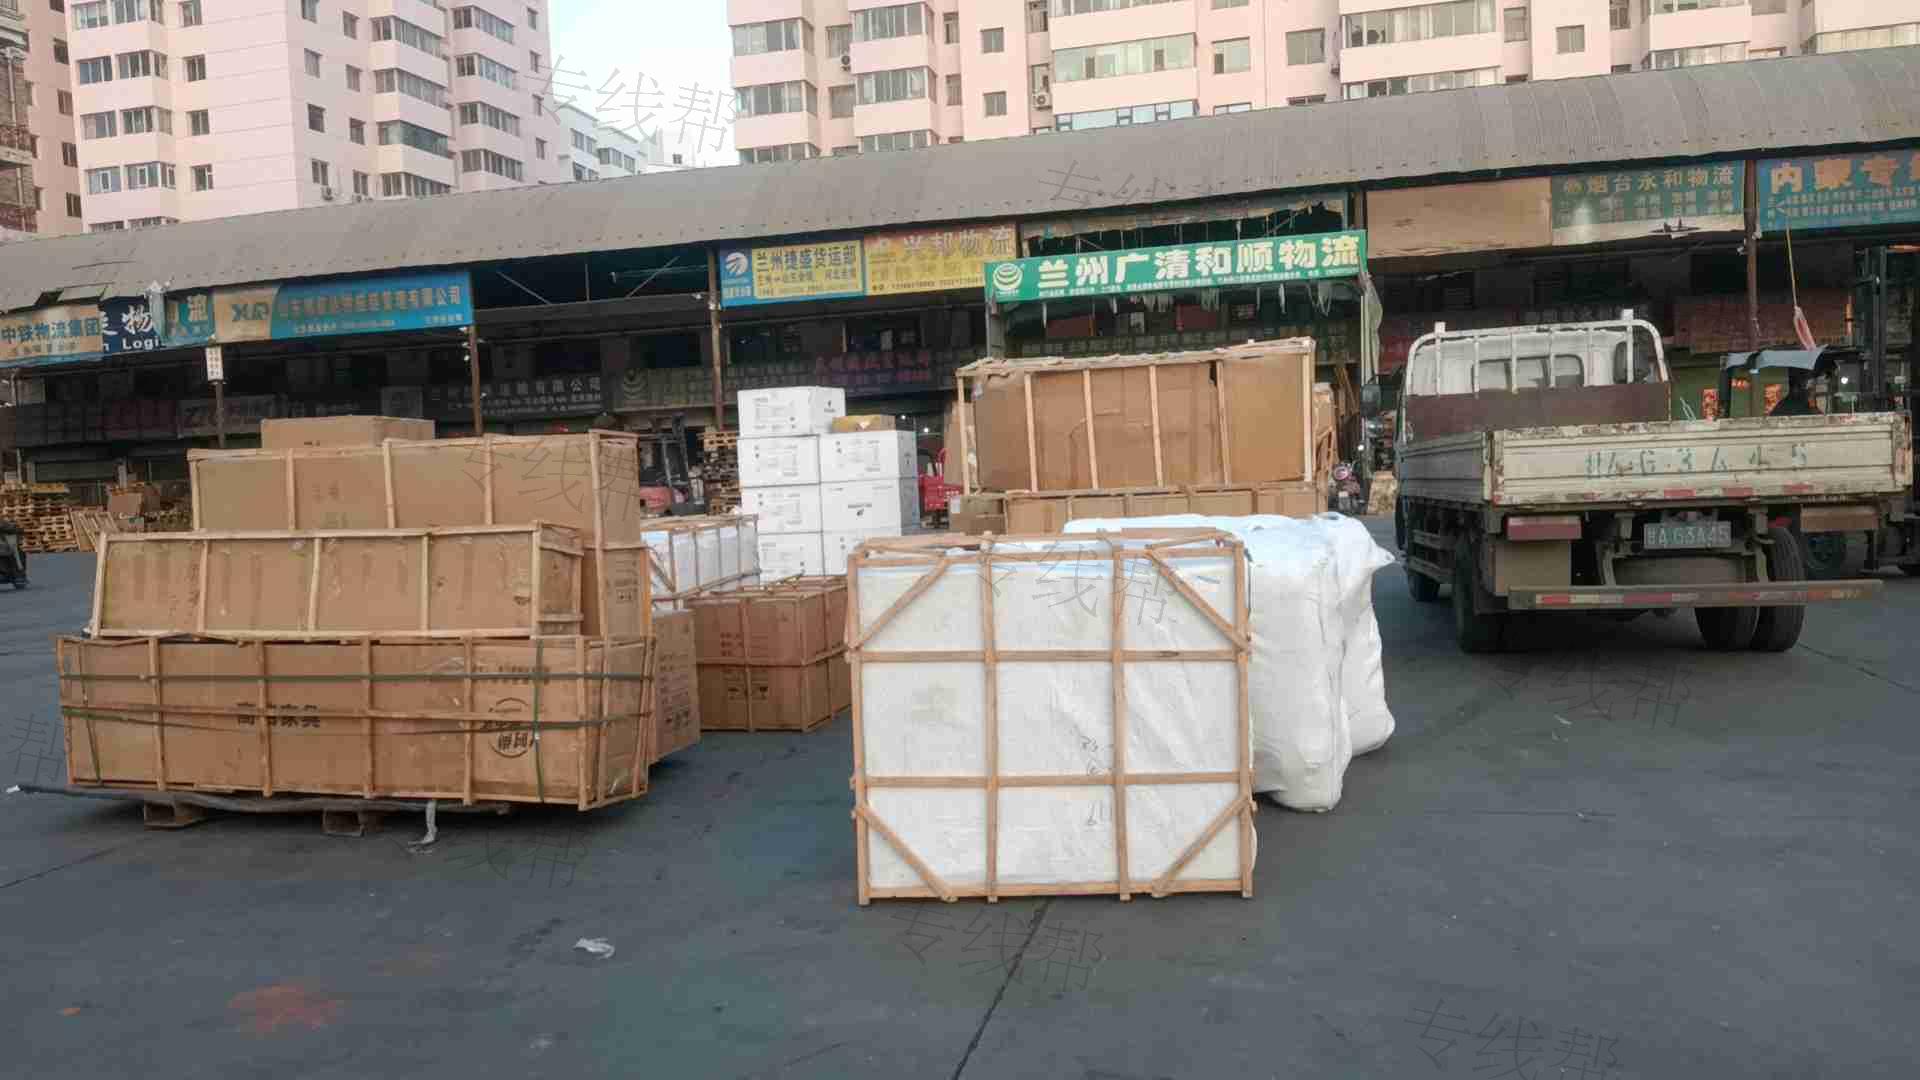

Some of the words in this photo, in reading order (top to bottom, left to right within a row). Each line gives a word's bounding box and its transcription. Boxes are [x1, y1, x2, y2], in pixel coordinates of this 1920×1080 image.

[1038, 235, 1359, 289] 兰州广清和顺物流
